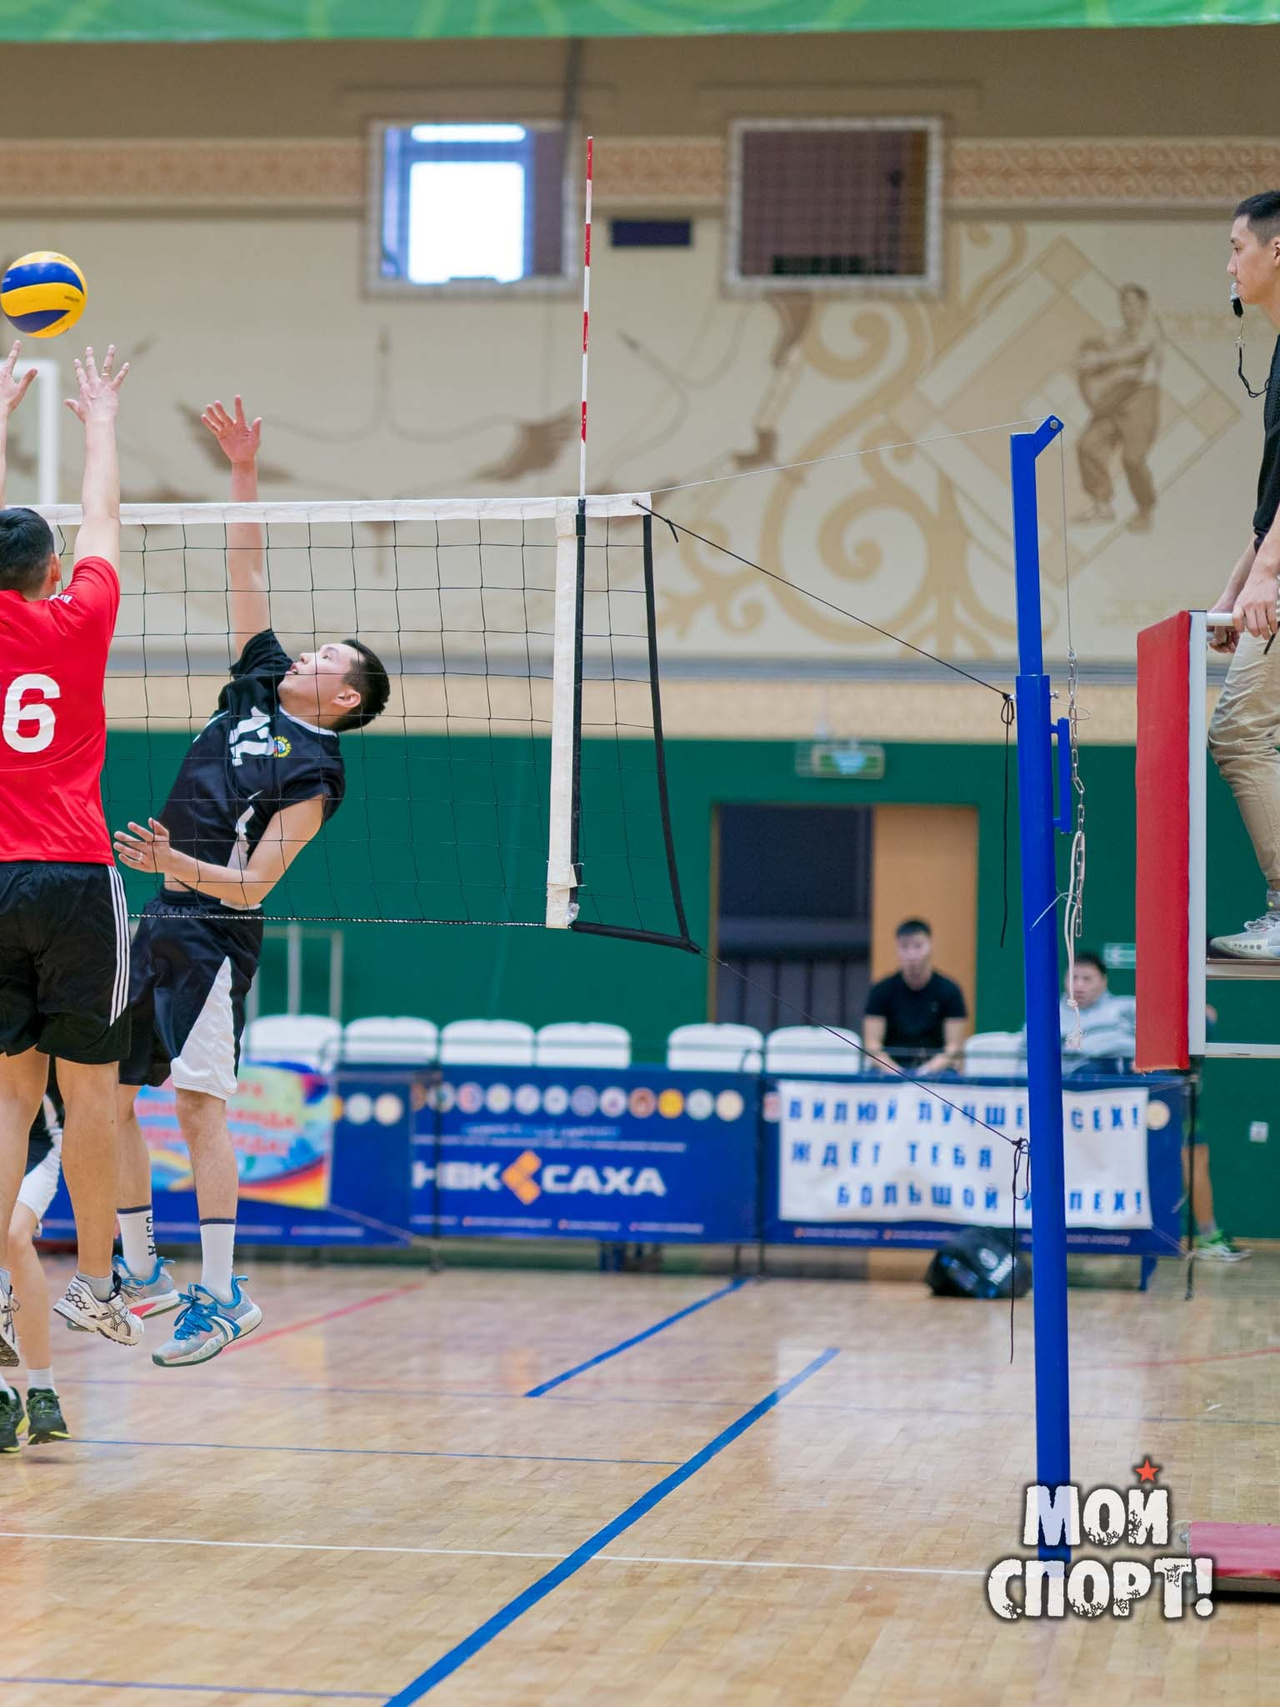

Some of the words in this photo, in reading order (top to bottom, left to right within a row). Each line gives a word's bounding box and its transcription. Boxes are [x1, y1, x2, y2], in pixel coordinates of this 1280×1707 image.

[919, 1101, 1025, 1127] ЛУЧШЕ
[1070, 1105, 1139, 1131] СЕХ!
[908, 1141, 992, 1169] ТЕБЯ
[541, 1163, 667, 1197] САХА
[836, 1182, 998, 1210] БОЛЬШОЙ
[1024, 1189, 1142, 1213] УПЕХ!
